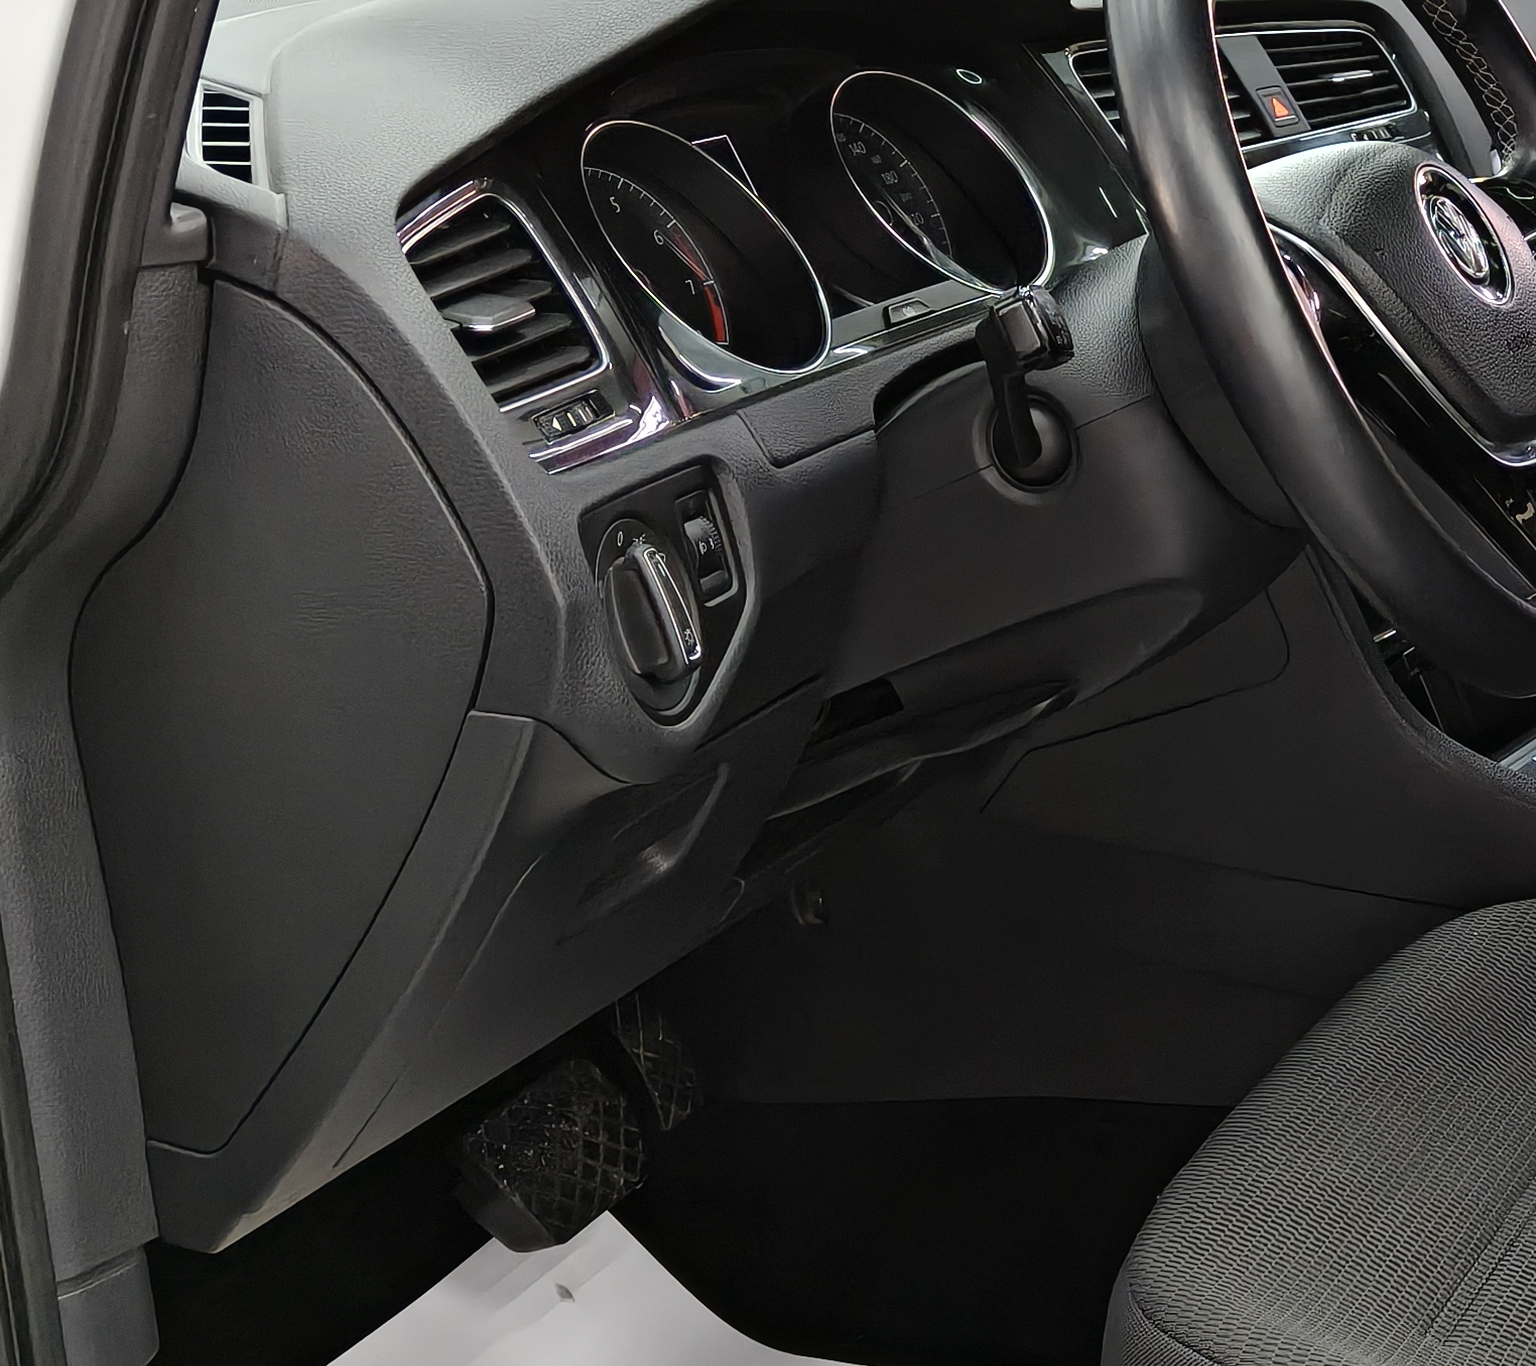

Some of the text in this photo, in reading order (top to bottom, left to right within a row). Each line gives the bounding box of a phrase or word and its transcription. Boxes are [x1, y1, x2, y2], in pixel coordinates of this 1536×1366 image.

[609, 196, 621, 214] 5
[653, 229, 665, 245] 6
[684, 279, 696, 296] 7
